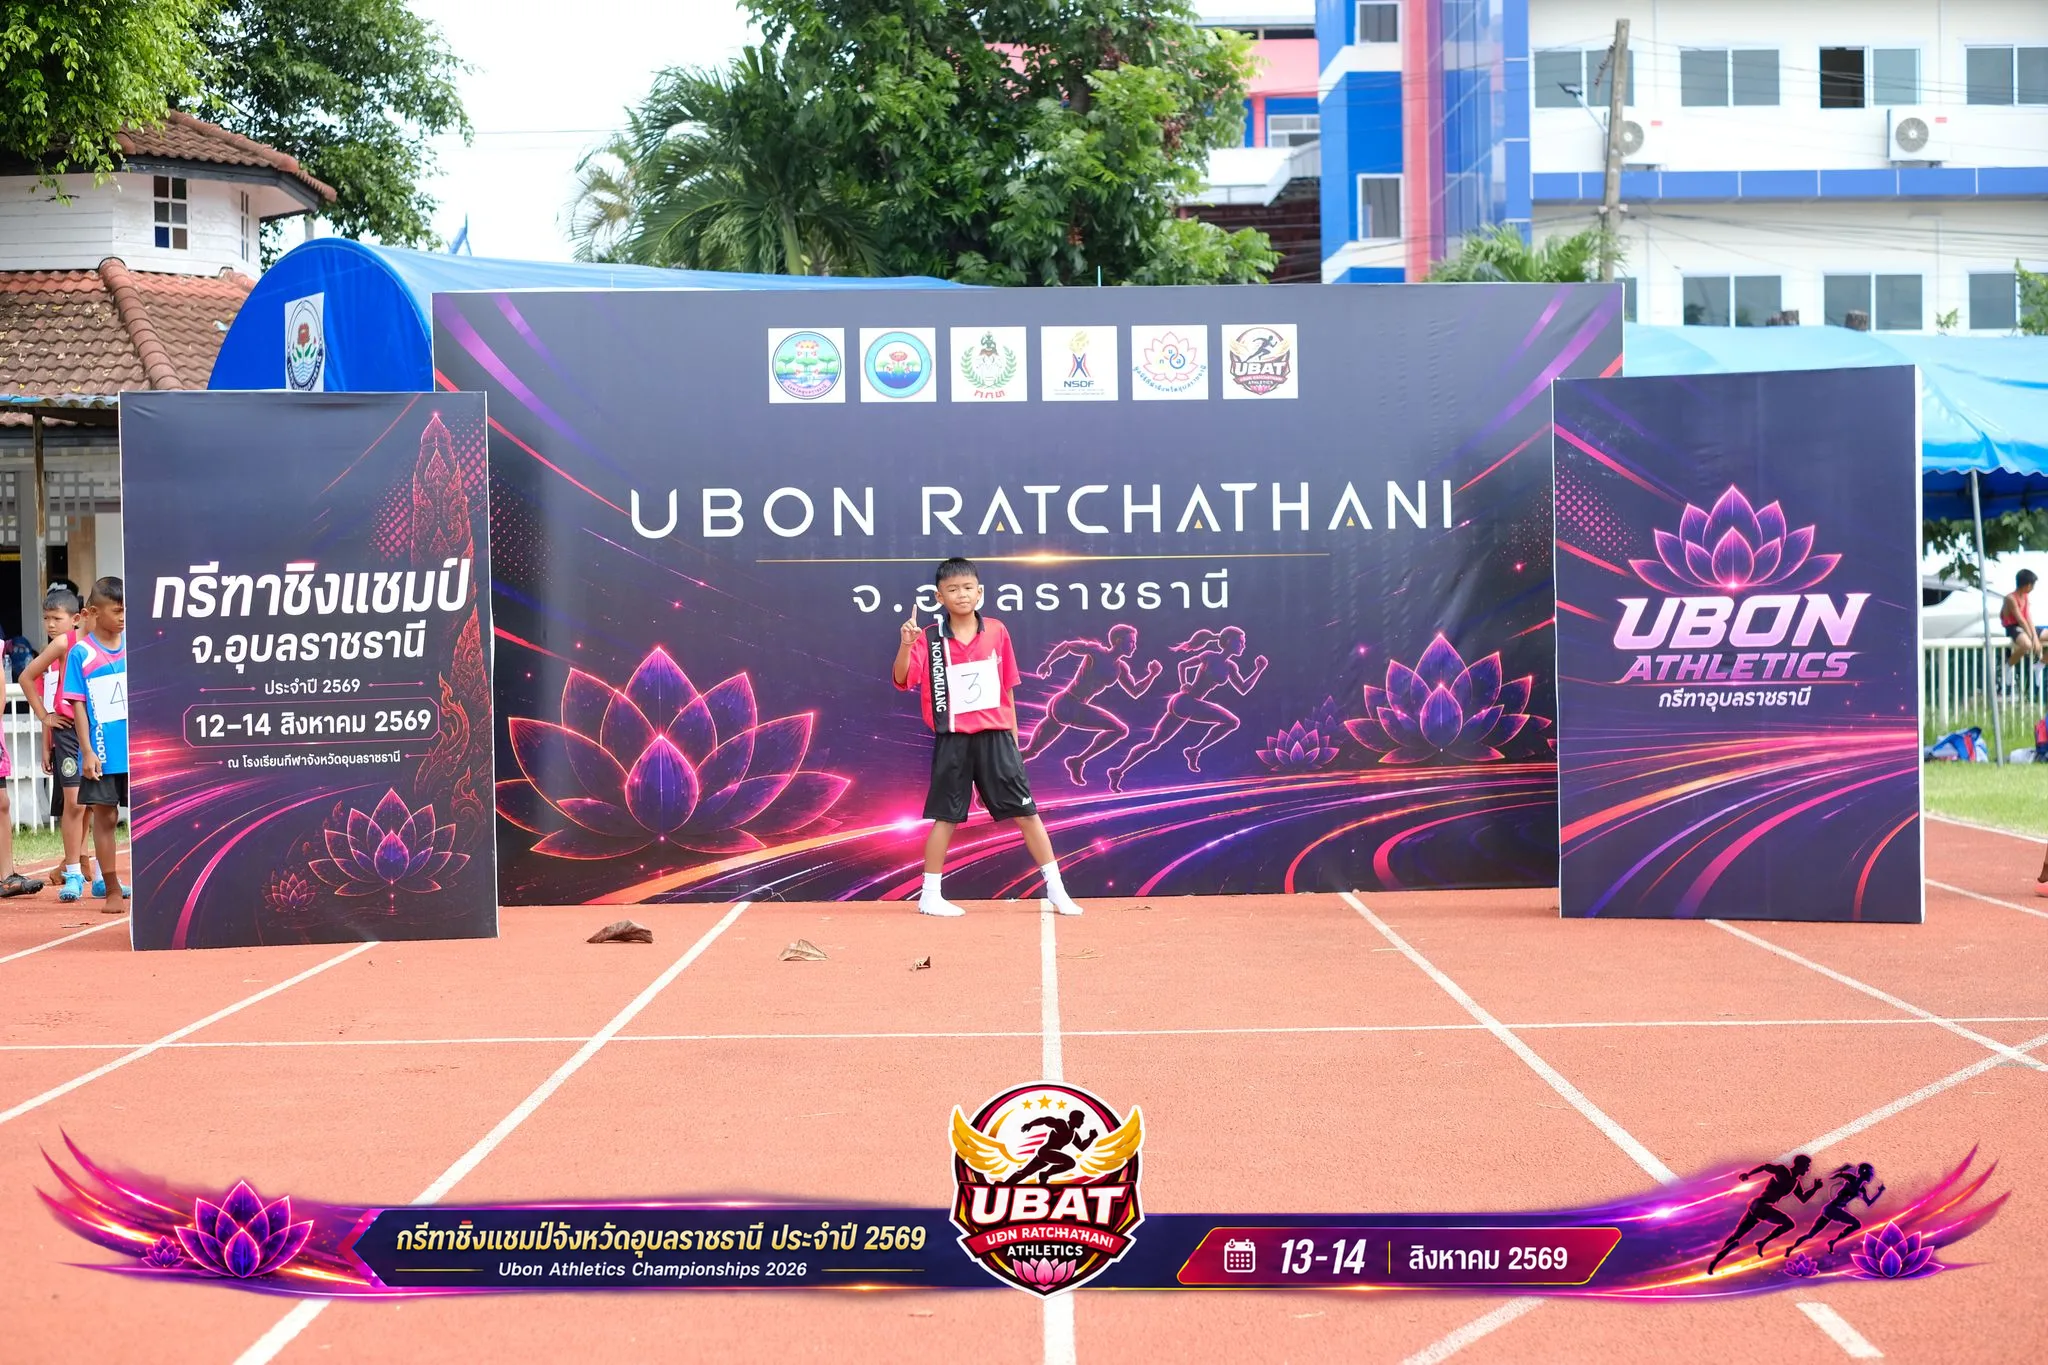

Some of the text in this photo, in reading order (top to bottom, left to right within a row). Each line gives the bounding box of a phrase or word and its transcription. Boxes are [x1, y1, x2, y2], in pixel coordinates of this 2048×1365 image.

[1063, 380, 1095, 388] NSDF
[1235, 362, 1287, 376] UBAT
[631, 480, 1454, 540] UBON RATCHATHANI
[151, 557, 472, 619] กรีฑาชิงแชมป์
[852, 568, 1229, 625] จ.อุลราชธานี
[1613, 592, 1872, 650] UBON
[191, 619, 427, 674] จ.อุบลราชธานี
[931, 641, 947, 713] NONGMUANG
[1610, 651, 1864, 684] ATHLETICS
[110, 681, 127, 711] 4
[264, 678, 361, 695] ประจำปี 2569
[961, 672, 982, 704] 3
[1658, 686, 1812, 713] กรีฑาอุบลราชธานี
[280, 711, 366, 735] สิงหาคม
[374, 709, 432, 732] 2569
[227, 750, 401, 769] ณ โรงเรียนกีฬาจังหวัดอุบลราชธานี
